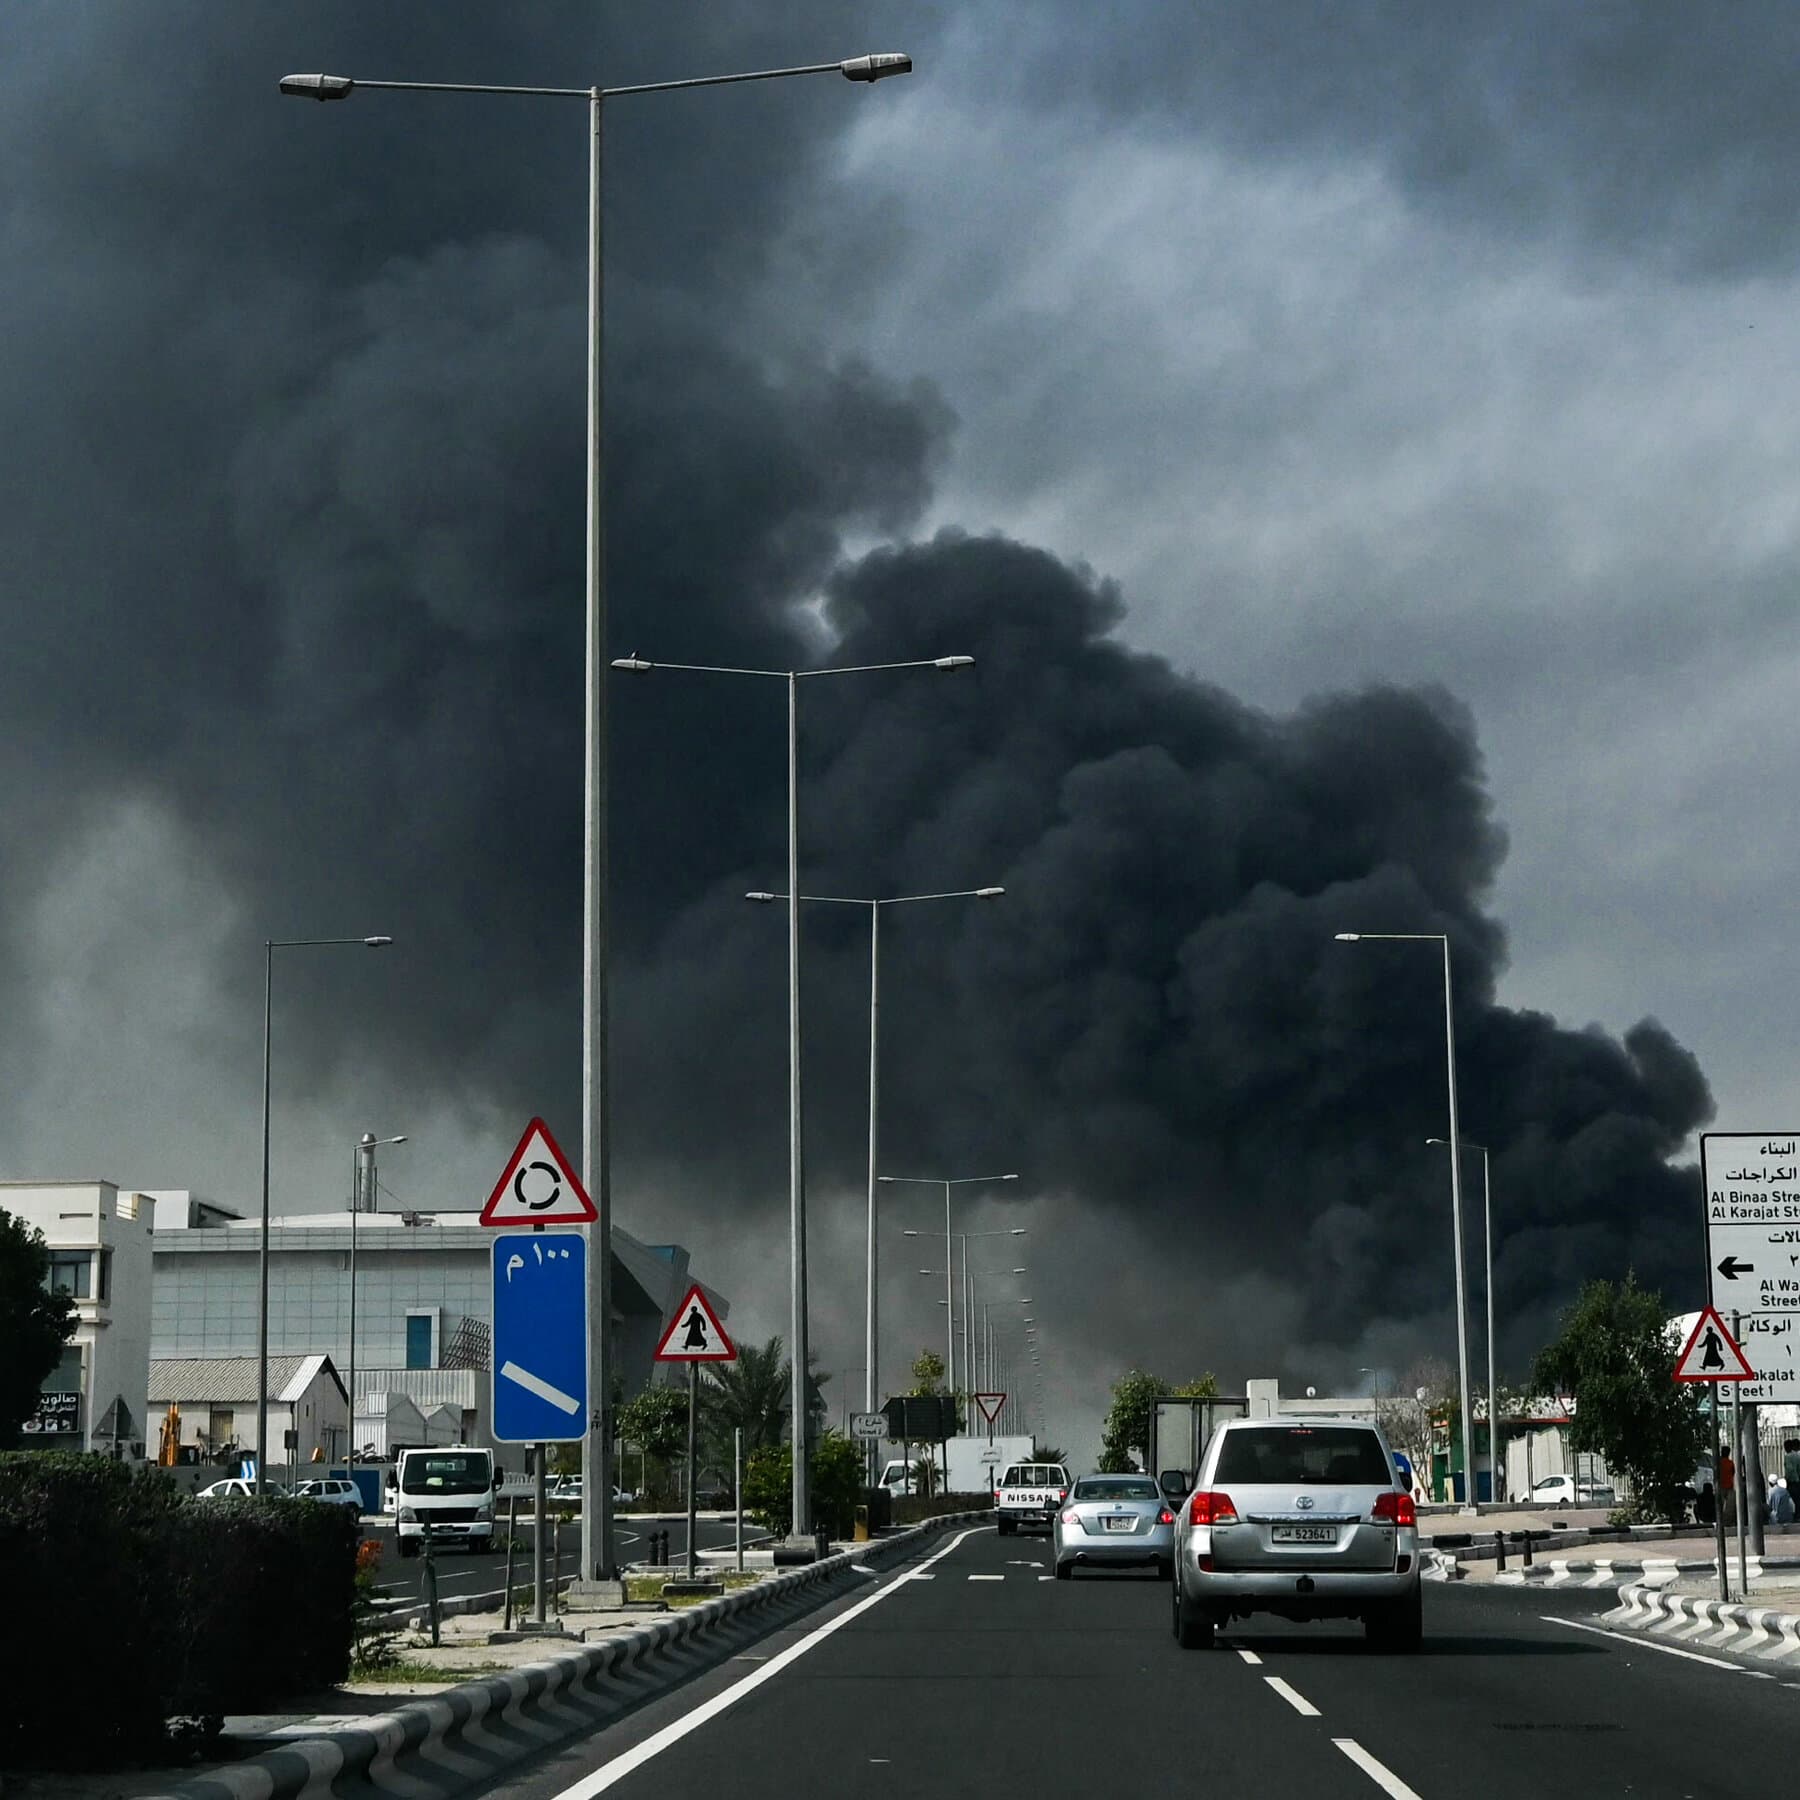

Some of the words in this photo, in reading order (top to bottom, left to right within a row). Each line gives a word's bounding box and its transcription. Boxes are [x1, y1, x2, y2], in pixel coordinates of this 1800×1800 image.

[1760, 1141, 1796, 1158] البناء
[1725, 1166, 1797, 1183] الكراجات
[1711, 1191, 1725, 1203] Al
[1730, 1191, 1768, 1203] Binaa
[1712, 1206, 1726, 1218] Al
[1731, 1206, 1779, 1220] Karajat
[1783, 1205, 1800, 1218] St
[1768, 1230, 1800, 1243] الات
[1790, 1254, 1799, 1267] ٢
[506, 1253, 524, 1283] م
[1760, 1279, 1774, 1291] Al
[1778, 1279, 1800, 1291] Wa
[1752, 1368, 1795, 1381] akalat
[1721, 1384, 1764, 1396] Seet
[1768, 1384, 1773, 1397] 1
[41, 1393, 77, 1405] صالون
[1007, 1494, 1053, 1502] NISSAN
[1295, 1528, 1331, 1540] 523641
